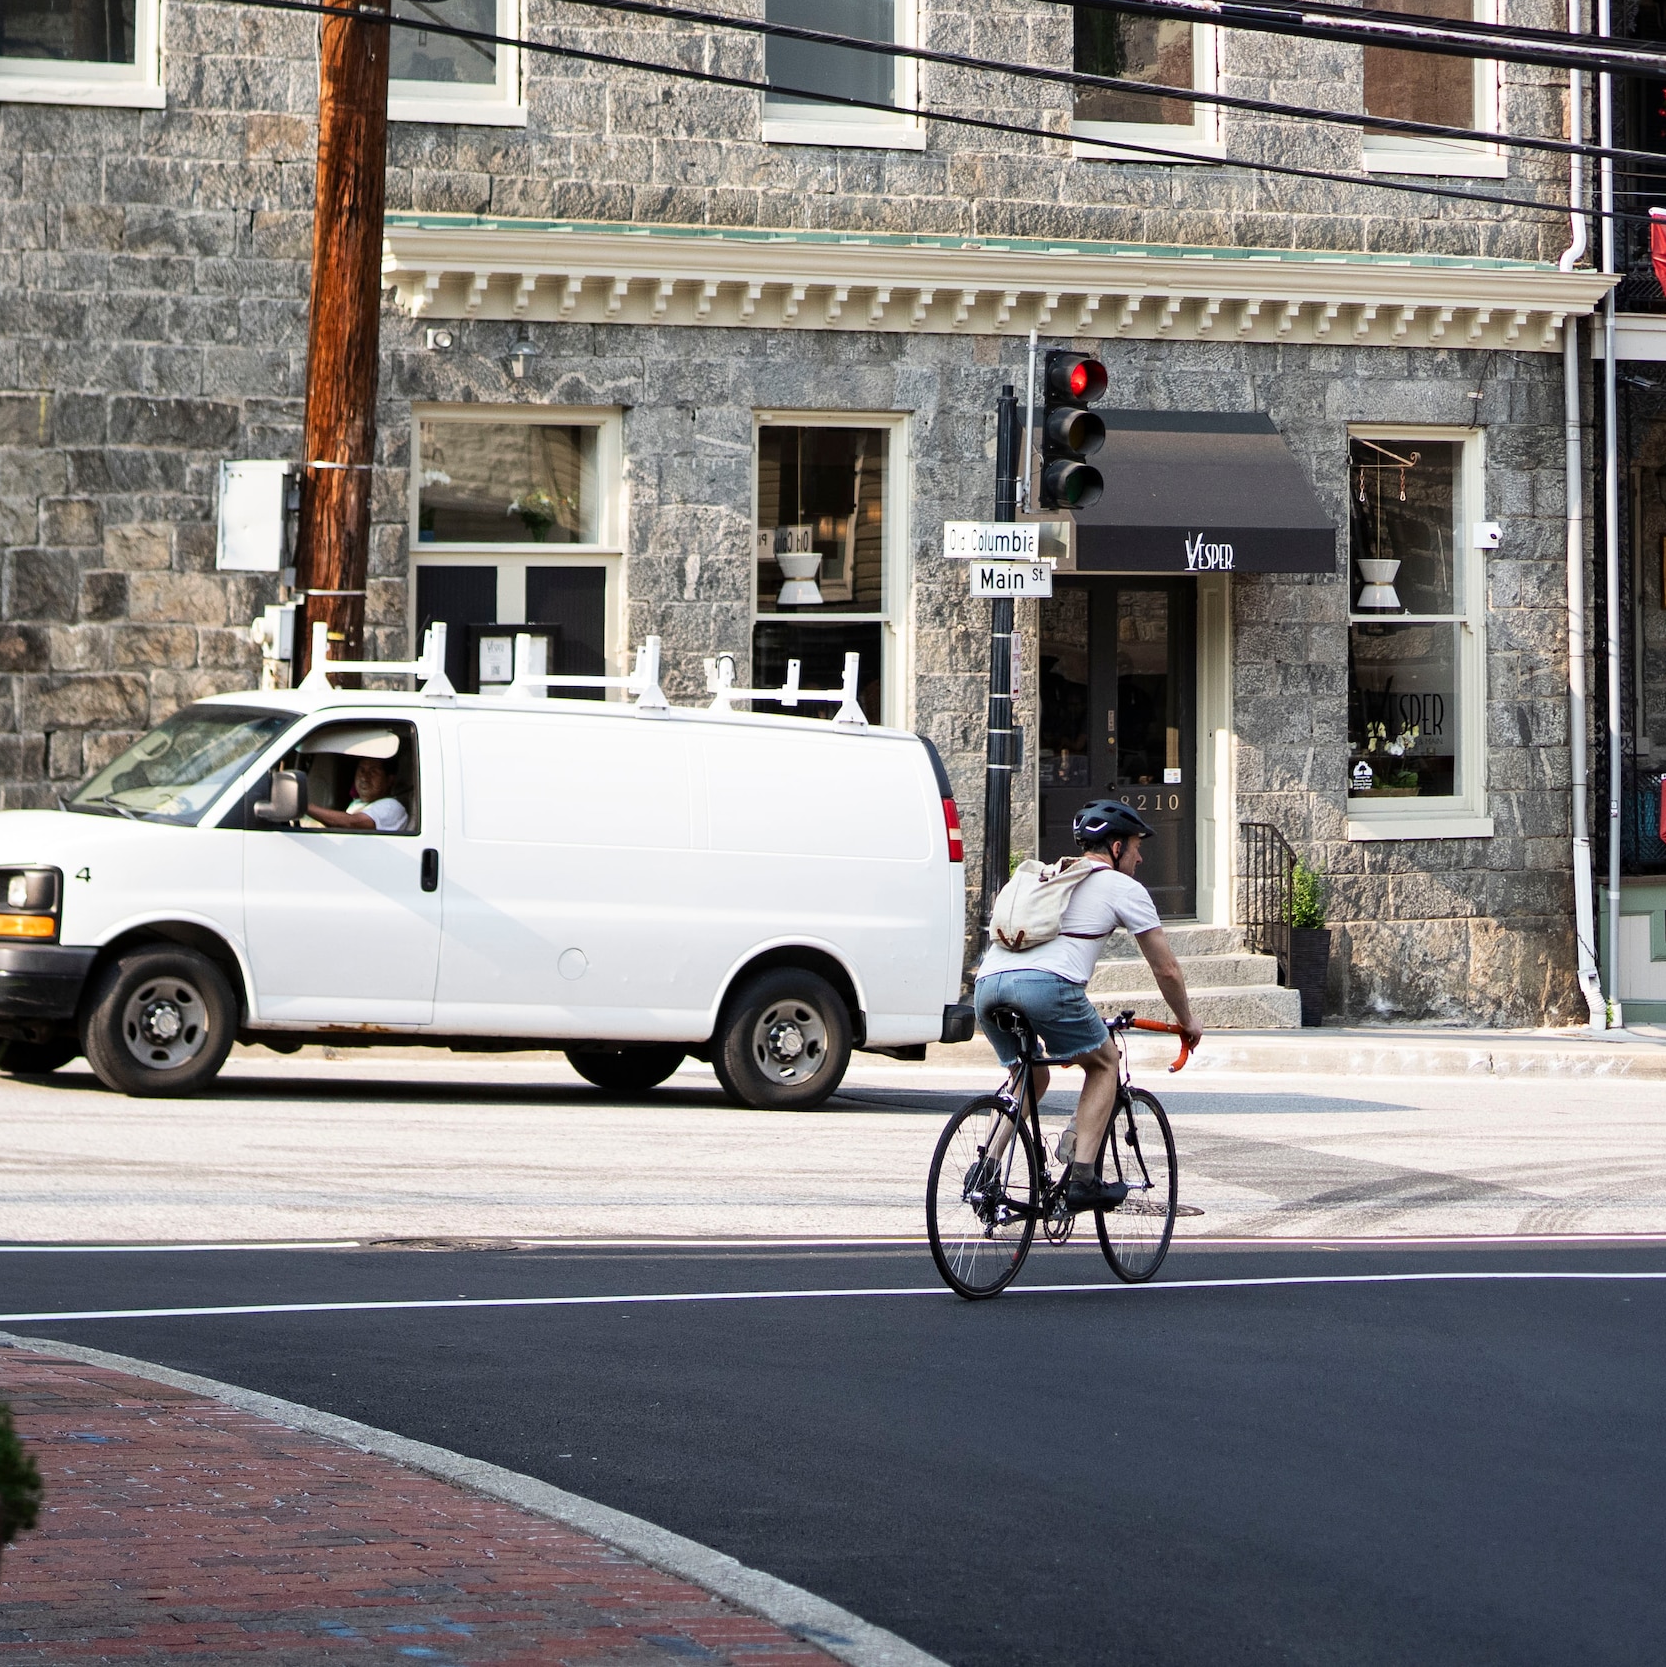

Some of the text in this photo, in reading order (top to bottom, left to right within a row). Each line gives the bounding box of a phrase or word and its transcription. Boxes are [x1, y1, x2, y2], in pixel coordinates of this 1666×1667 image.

[971, 529, 1034, 552] Columbia
[981, 567, 1046, 590] Main St.
[1364, 675, 1444, 739] VESPER
[1120, 794, 1179, 811] 8210
[75, 866, 91, 883] 4
